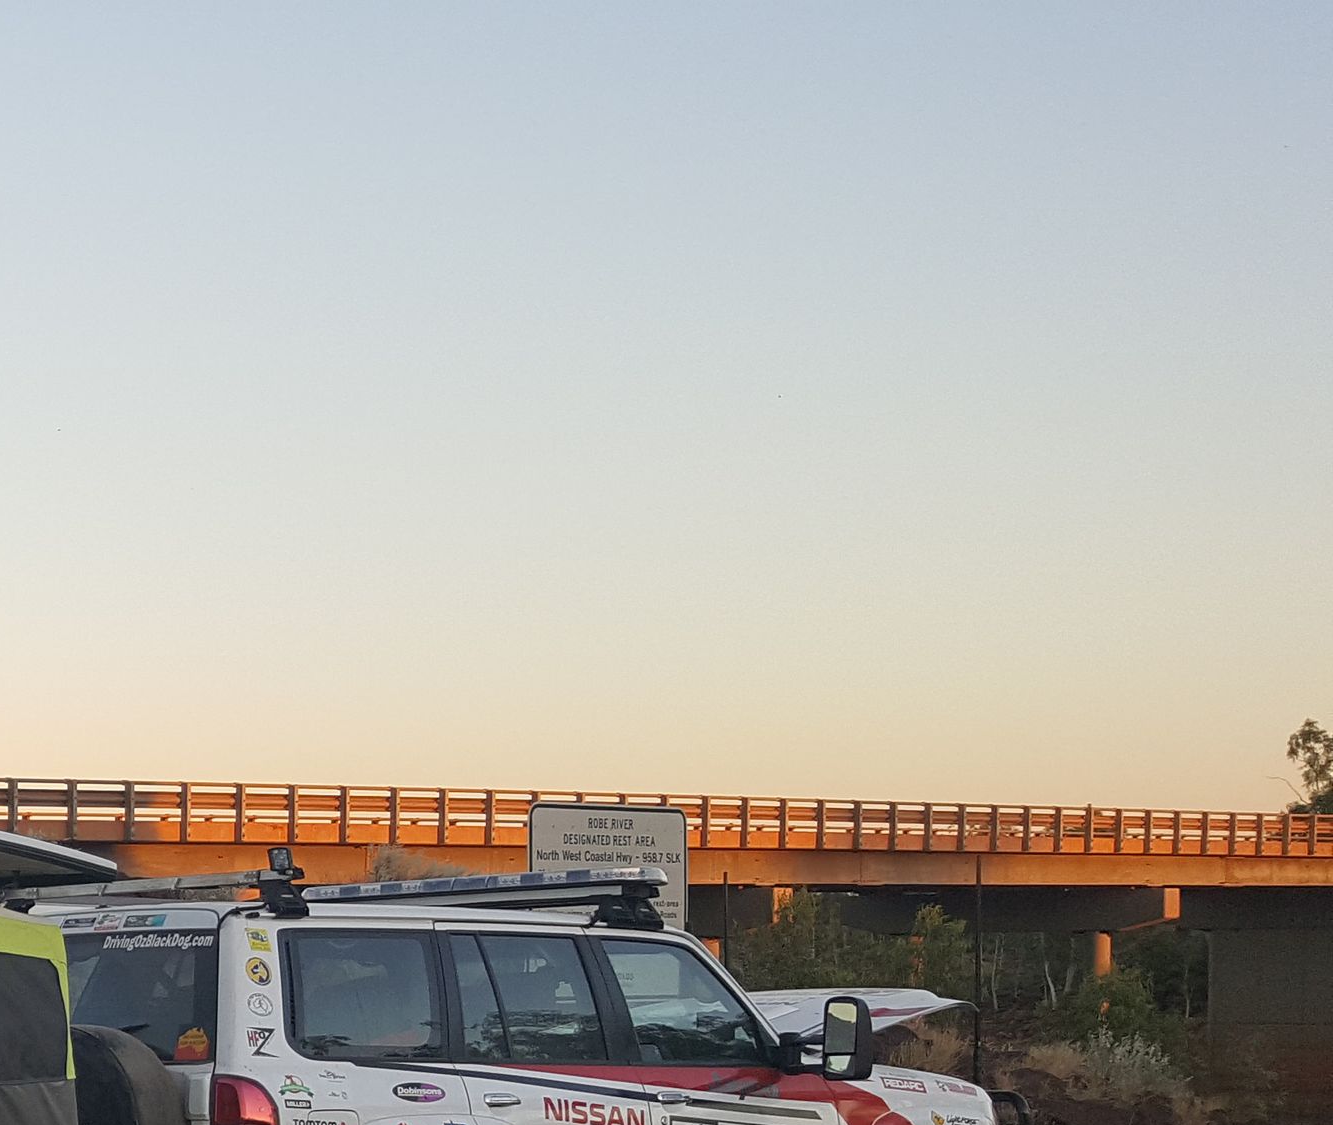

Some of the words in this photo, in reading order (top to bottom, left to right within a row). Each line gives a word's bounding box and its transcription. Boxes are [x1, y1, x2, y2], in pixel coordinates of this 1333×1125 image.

[588, 818, 608, 829] ROBE
[611, 818, 634, 830] RIVER
[563, 833, 611, 845] DESIGNATED
[613, 835, 631, 846] REST
[635, 836, 656, 847] AREA
[536, 850, 559, 861] North
[562, 850, 581, 862] West
[584, 851, 614, 862] Coastal
[616, 851, 633, 864] Hwy
[665, 853, 681, 863] SLK
[102, 933, 214, 951] DrivingOzBlackDog.com
[885, 1080, 924, 1091] REDARC
